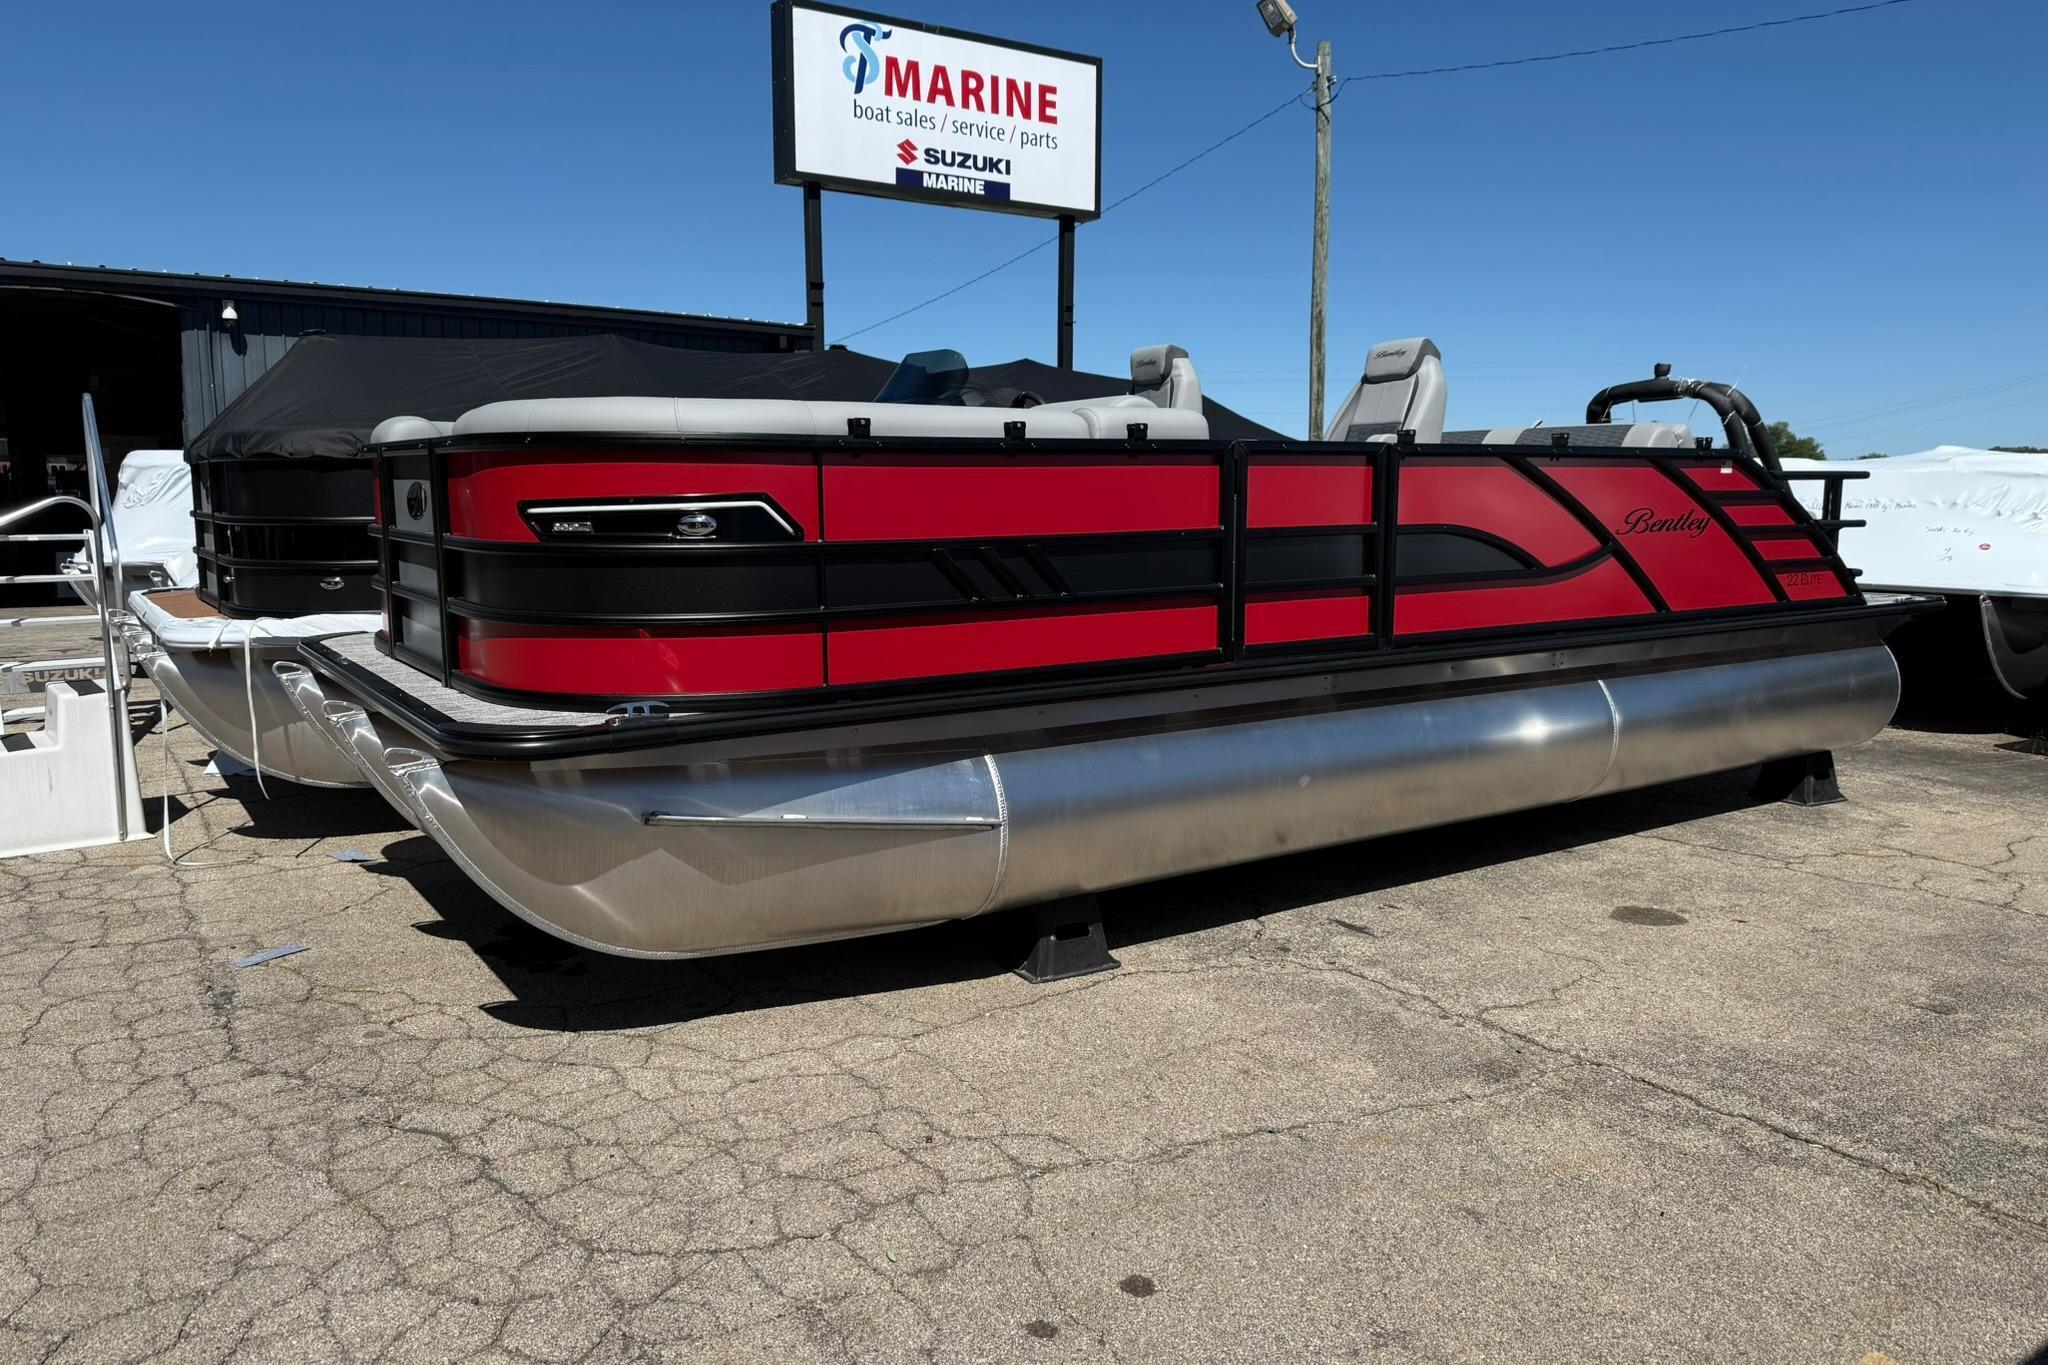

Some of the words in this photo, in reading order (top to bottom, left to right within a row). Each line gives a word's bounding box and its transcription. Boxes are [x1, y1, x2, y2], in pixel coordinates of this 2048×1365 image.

[884, 55, 1058, 125] MARINE
[853, 98, 891, 124] boat
[896, 107, 936, 130] sales
[951, 119, 1005, 142] service
[1020, 130, 1058, 150] parts
[923, 147, 1011, 176] SUZUKI
[922, 172, 985, 195] MARINE
[1614, 507, 1712, 539] Bentley
[1786, 573, 1800, 587] 22
[23, 667, 101, 683] SUZUKI
